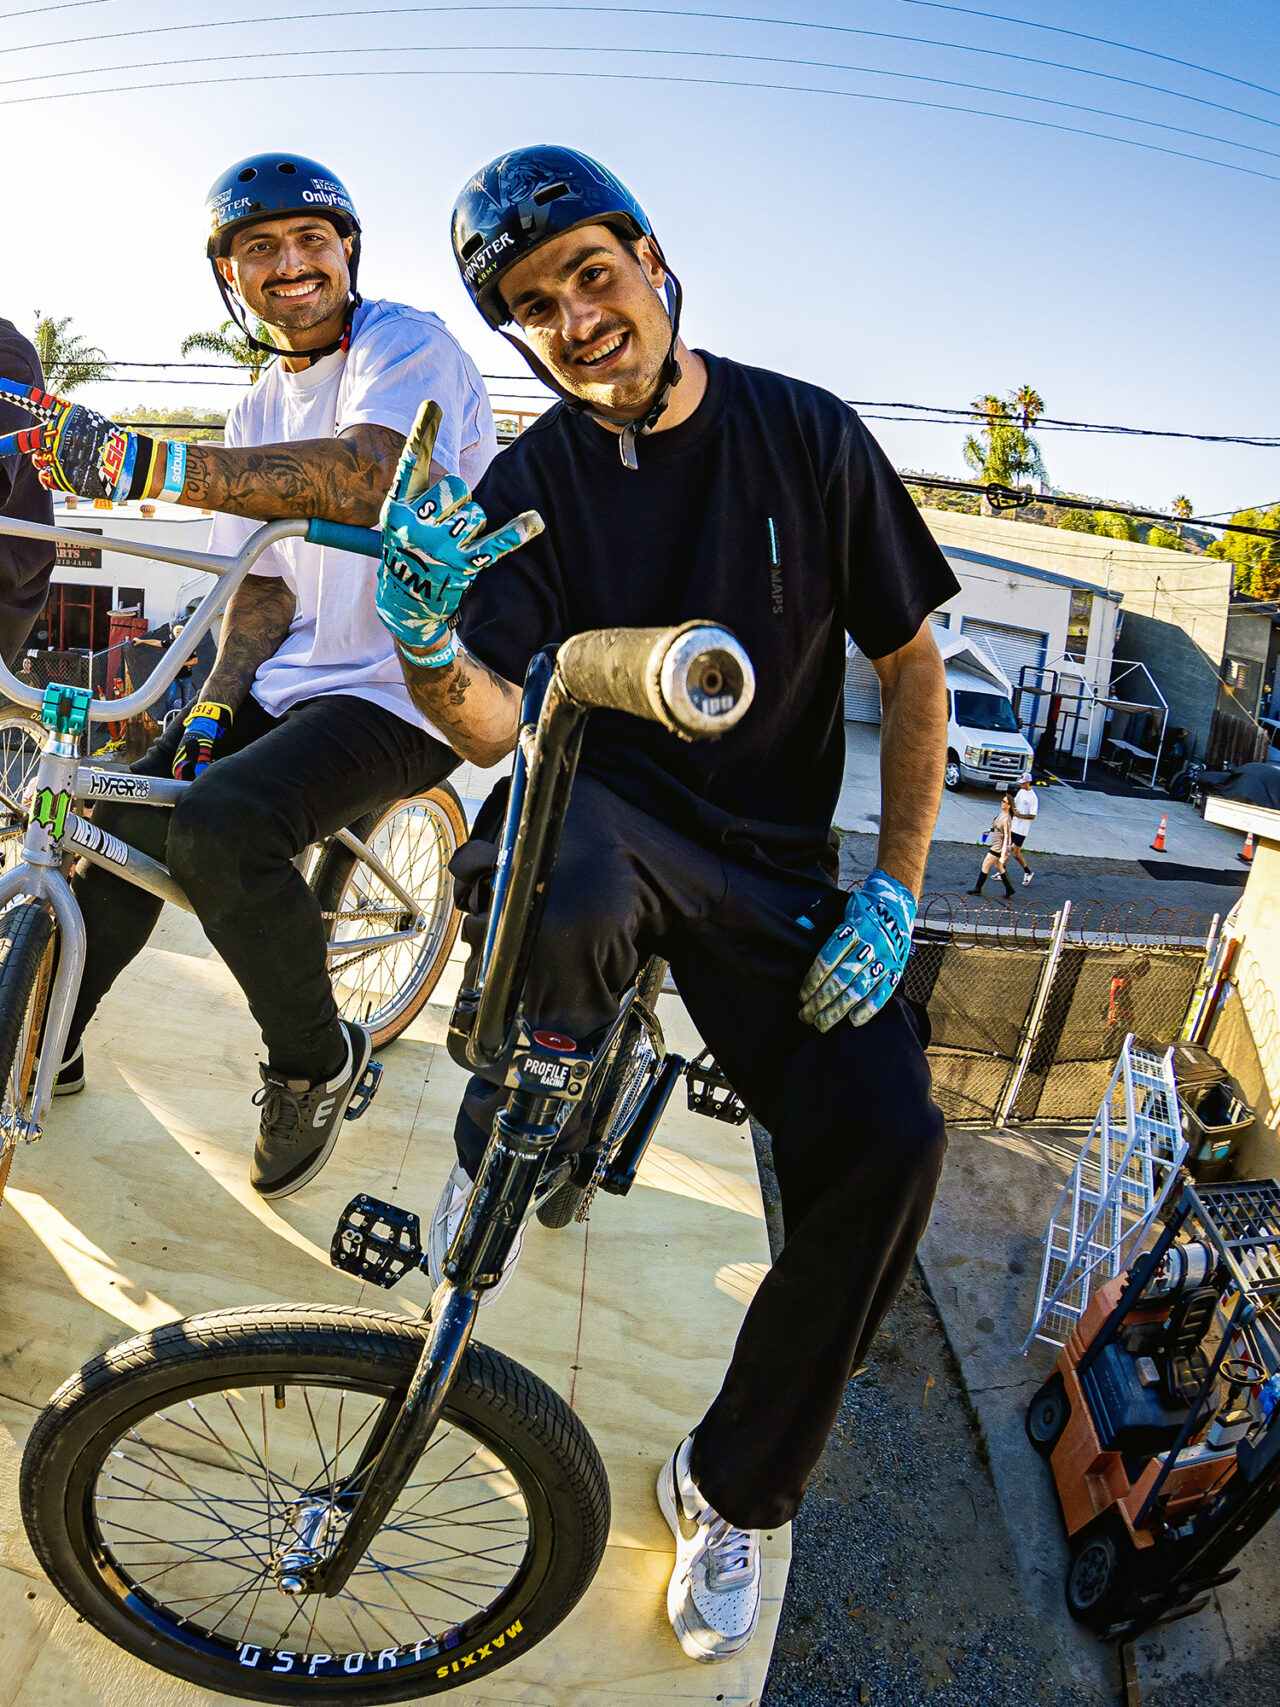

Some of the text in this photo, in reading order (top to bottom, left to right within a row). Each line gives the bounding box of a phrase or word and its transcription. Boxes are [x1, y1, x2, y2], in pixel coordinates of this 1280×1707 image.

[302, 190, 352, 211] OnlyFans
[462, 232, 516, 285] MONSTER
[477, 261, 499, 285] ARMY
[102, 431, 126, 486] FIST
[90, 774, 136, 796] HYPER
[523, 1058, 570, 1080] PROFILE
[540, 1076, 566, 1088] RACING
[239, 1638, 432, 1675] GSPORT
[436, 1618, 524, 1679] MAXXIS
